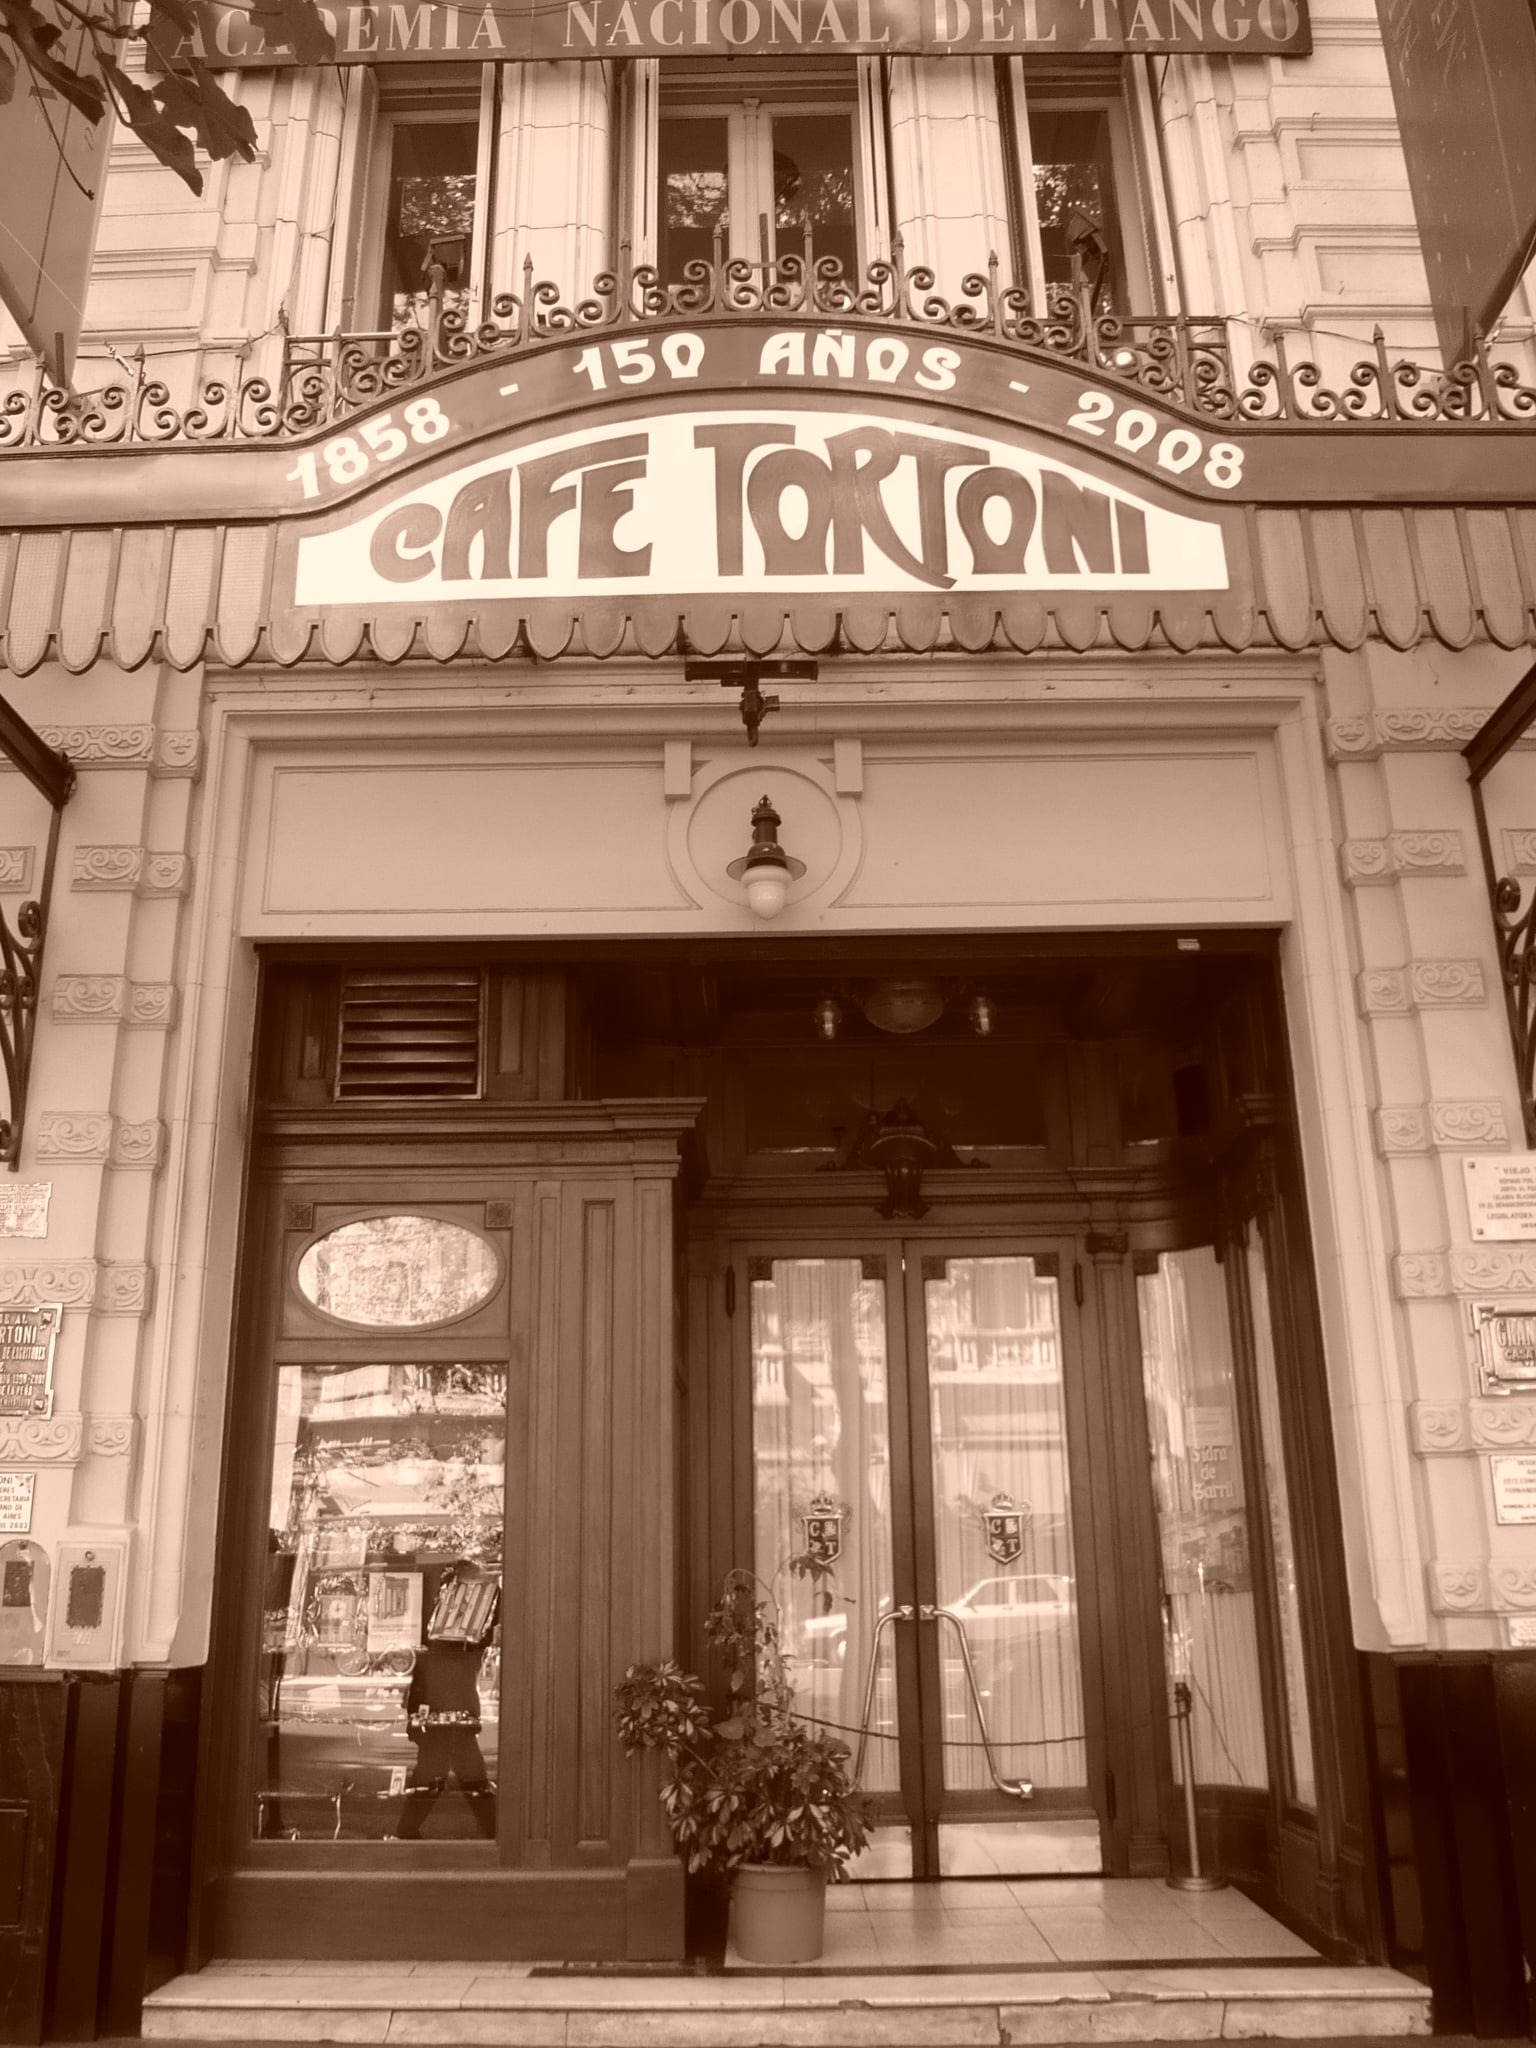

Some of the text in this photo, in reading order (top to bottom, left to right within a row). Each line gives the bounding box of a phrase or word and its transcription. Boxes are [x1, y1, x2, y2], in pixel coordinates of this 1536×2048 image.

[170, 2, 506, 59] ACEMIA
[563, 0, 890, 47] NACIONAL
[932, 0, 1057, 42] DEL
[1079, 0, 1300, 42] TANGO
[287, 397, 451, 499] 1858
[573, 332, 706, 391] 150
[758, 329, 962, 391] AÑOS
[1066, 391, 1246, 490] 2008
[369, 422, 1151, 590] CAFE TORTONI
[1200, 1463, 1217, 1480] de
